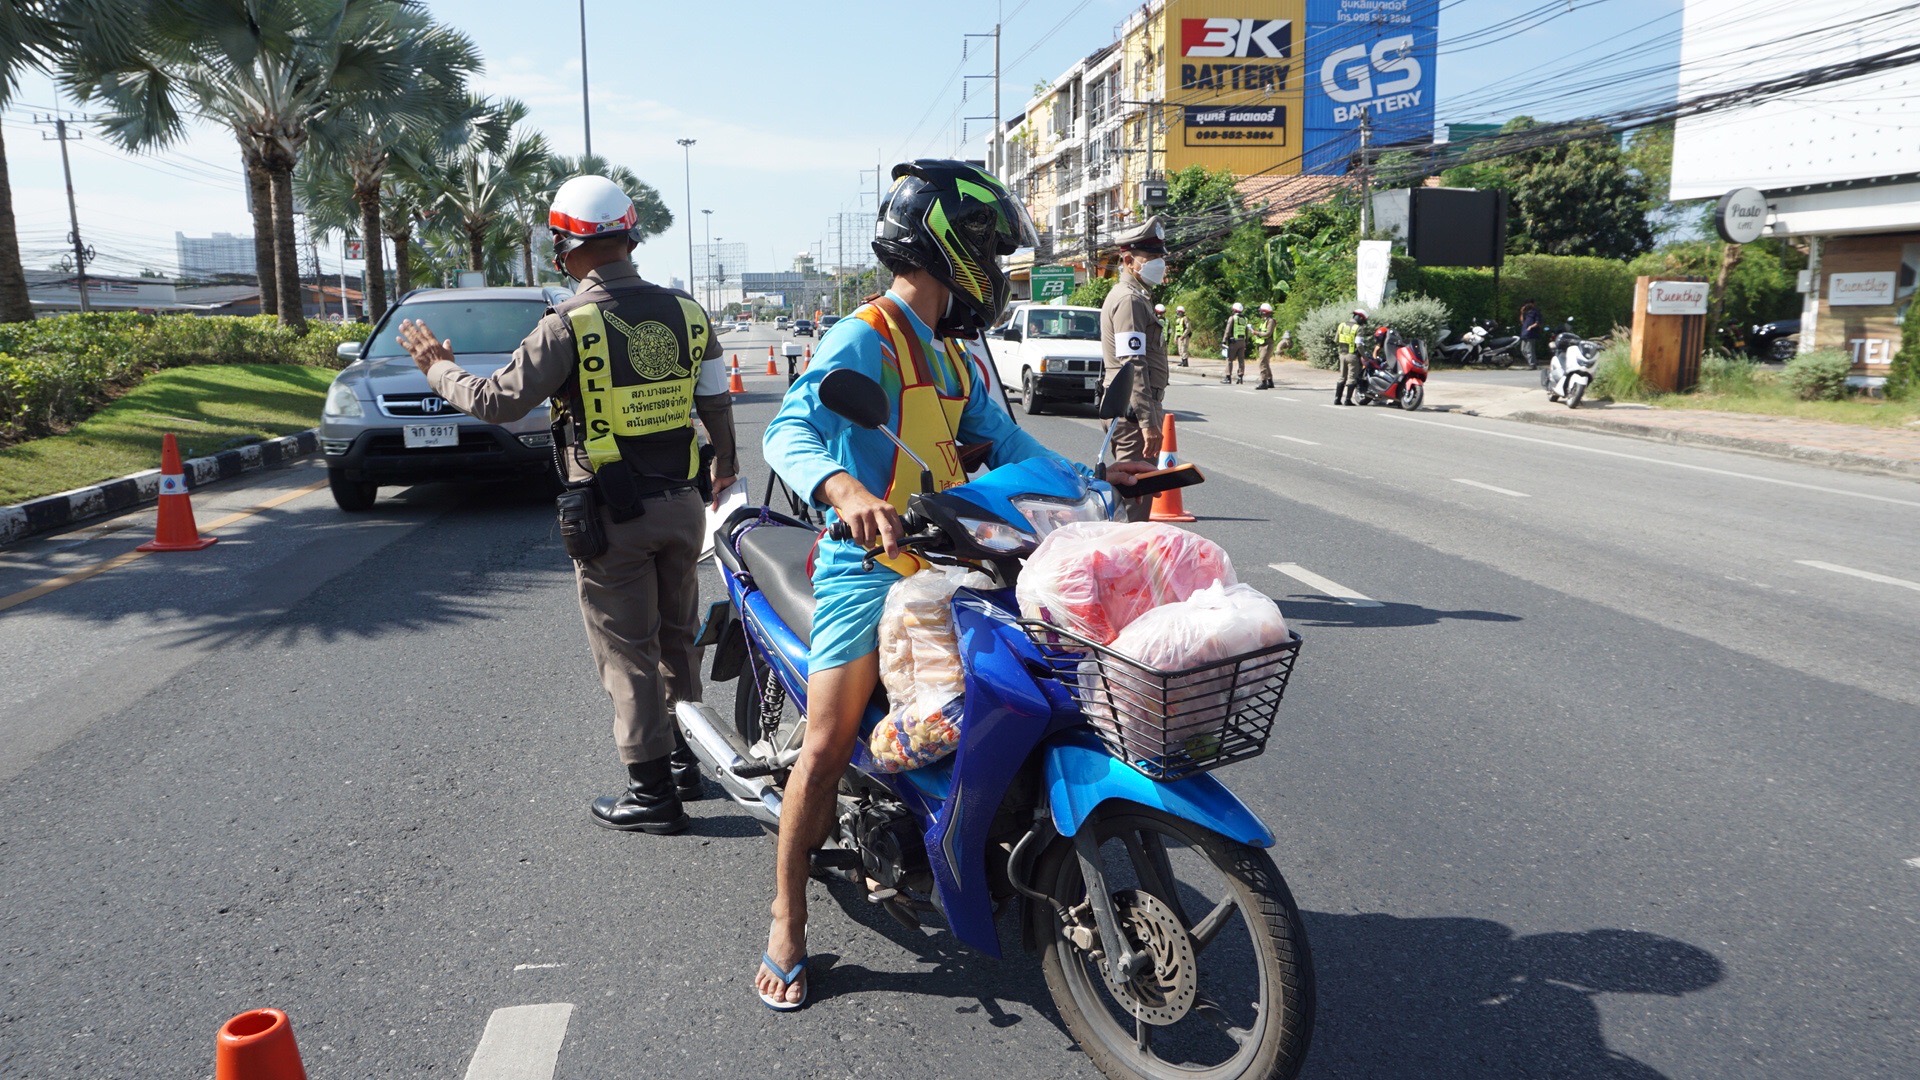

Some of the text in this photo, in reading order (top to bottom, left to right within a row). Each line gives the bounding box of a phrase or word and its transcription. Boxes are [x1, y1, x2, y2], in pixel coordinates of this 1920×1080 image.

[1182, 64, 1291, 90] BATTERY
[1320, 34, 1422, 103] GS
[1333, 90, 1423, 123] BATTERY
[1196, 130, 1274, 140] 098-552-3894
[1042, 280, 1065, 292] FB
[582, 333, 611, 442] POLIC
[430, 426, 454, 436] 6917
